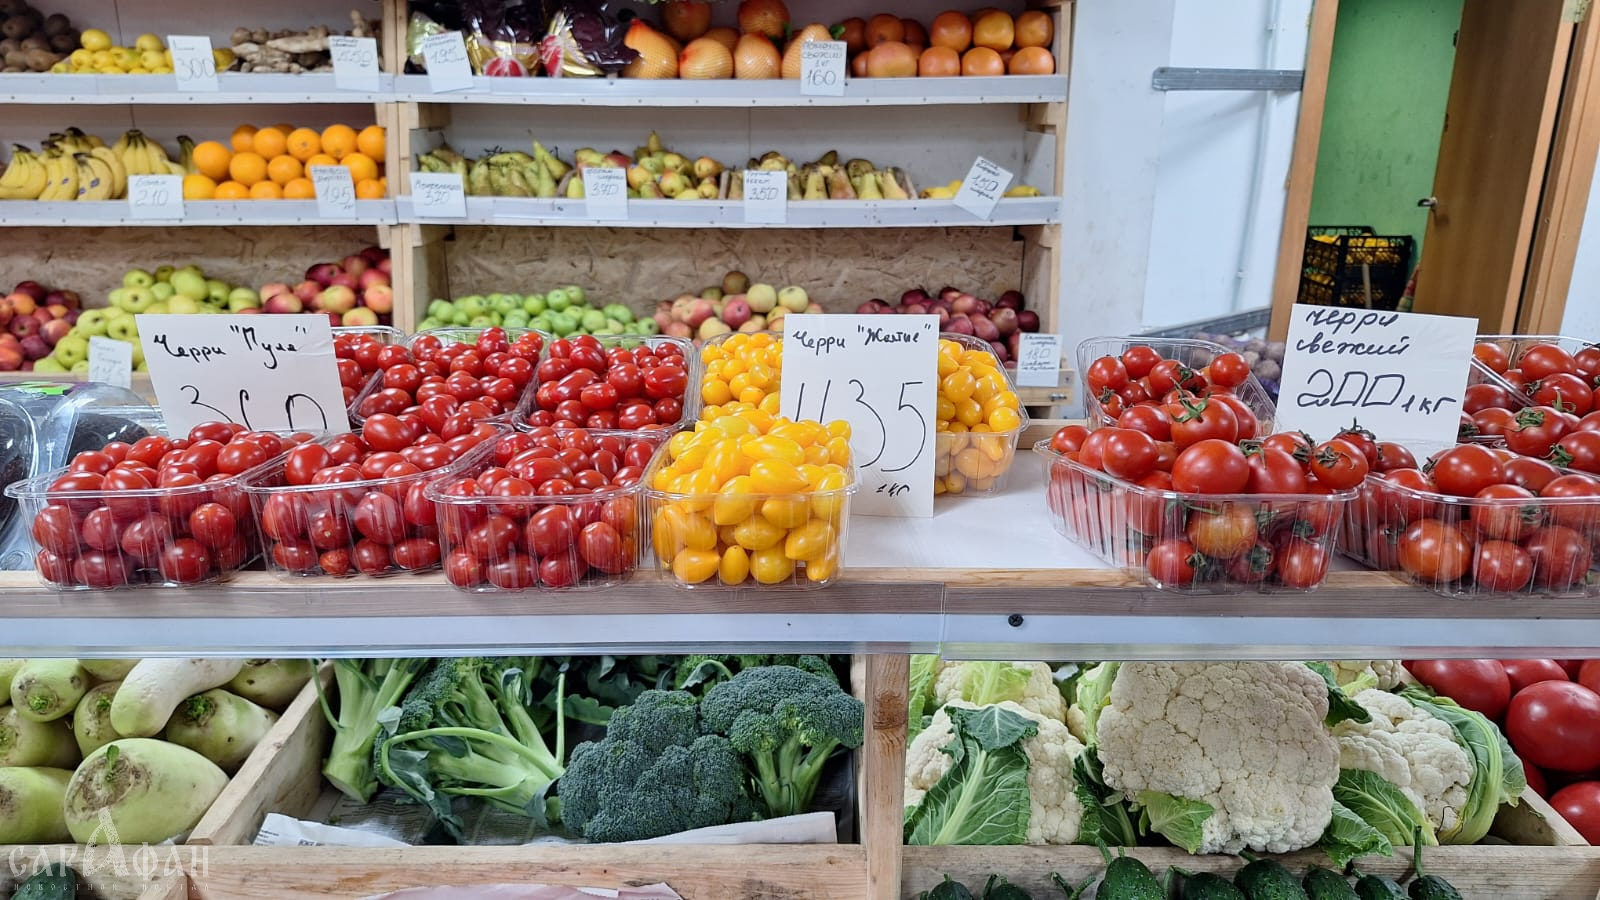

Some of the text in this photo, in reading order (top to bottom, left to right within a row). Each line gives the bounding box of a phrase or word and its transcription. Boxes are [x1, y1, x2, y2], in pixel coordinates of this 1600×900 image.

[176, 57, 215, 81] 300
[807, 69, 837, 86] 160
[135, 189, 169, 208] 210
[153, 334, 226, 364] Черри
[792, 330, 847, 356] Черри
[1296, 331, 1410, 356] свежий
[1297, 368, 1405, 408] 200
